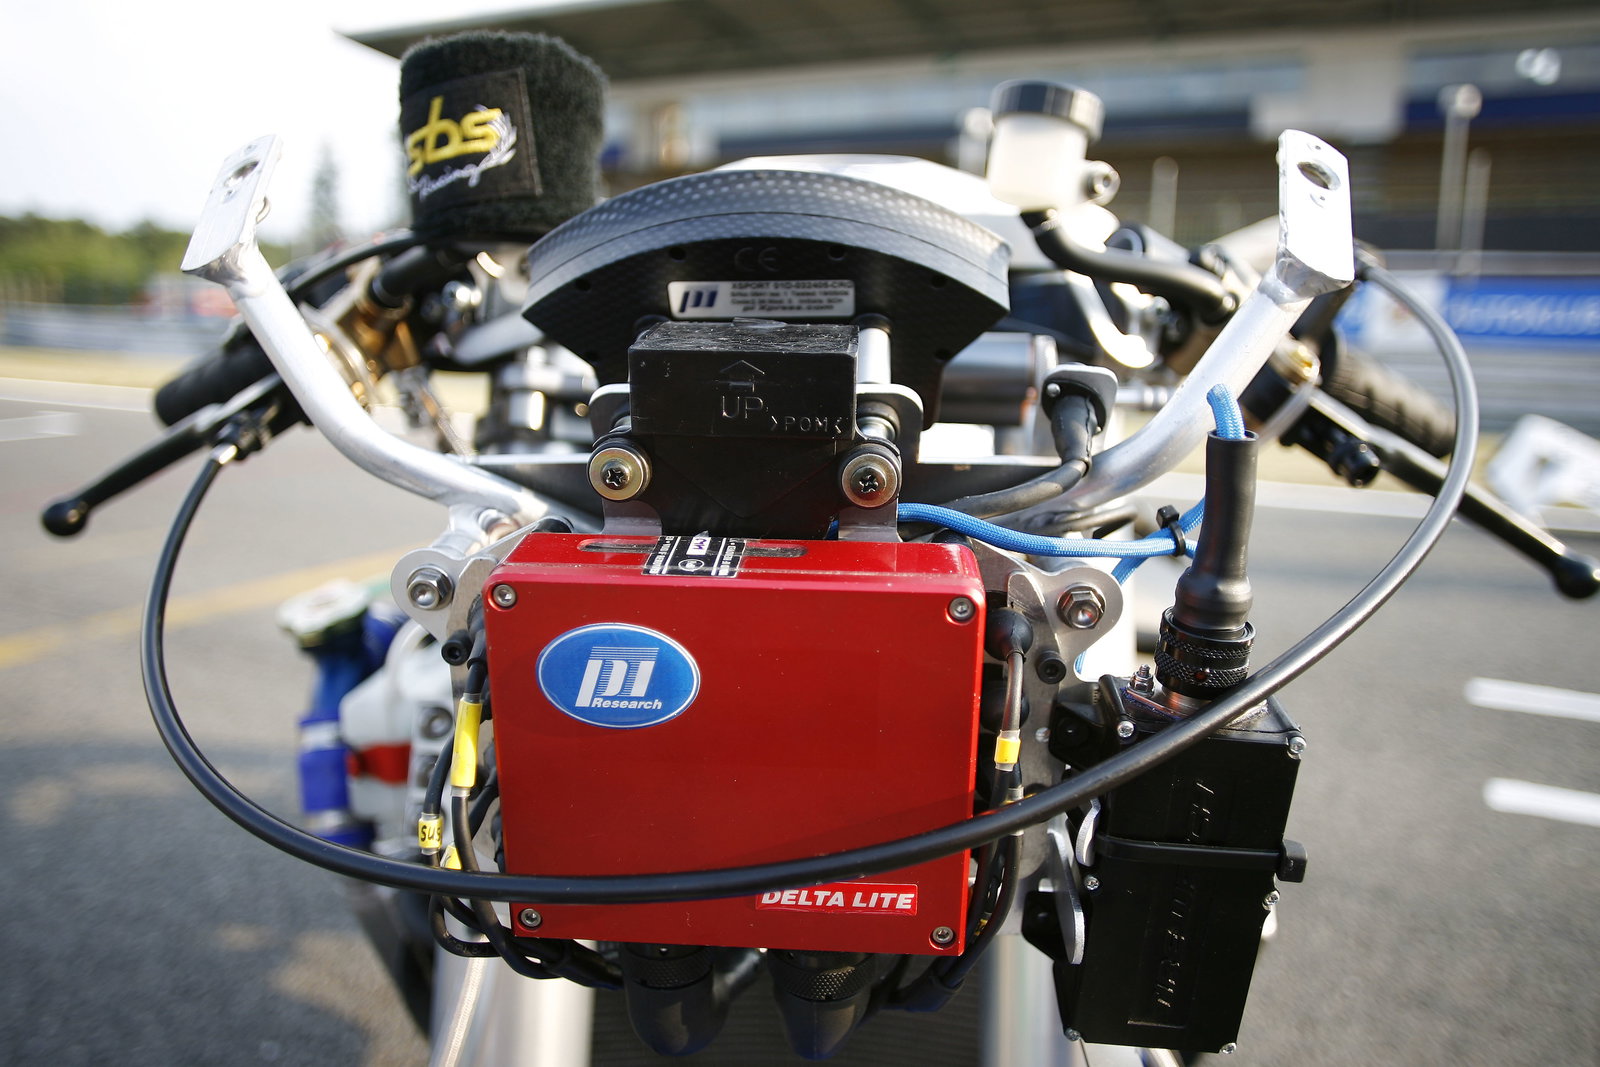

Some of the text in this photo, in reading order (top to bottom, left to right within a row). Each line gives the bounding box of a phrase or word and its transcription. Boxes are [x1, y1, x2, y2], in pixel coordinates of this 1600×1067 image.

[407, 95, 502, 176] sbs
[721, 395, 764, 419] UP
[591, 698, 662, 710] Research
[761, 890, 915, 909] DELTA LITE
